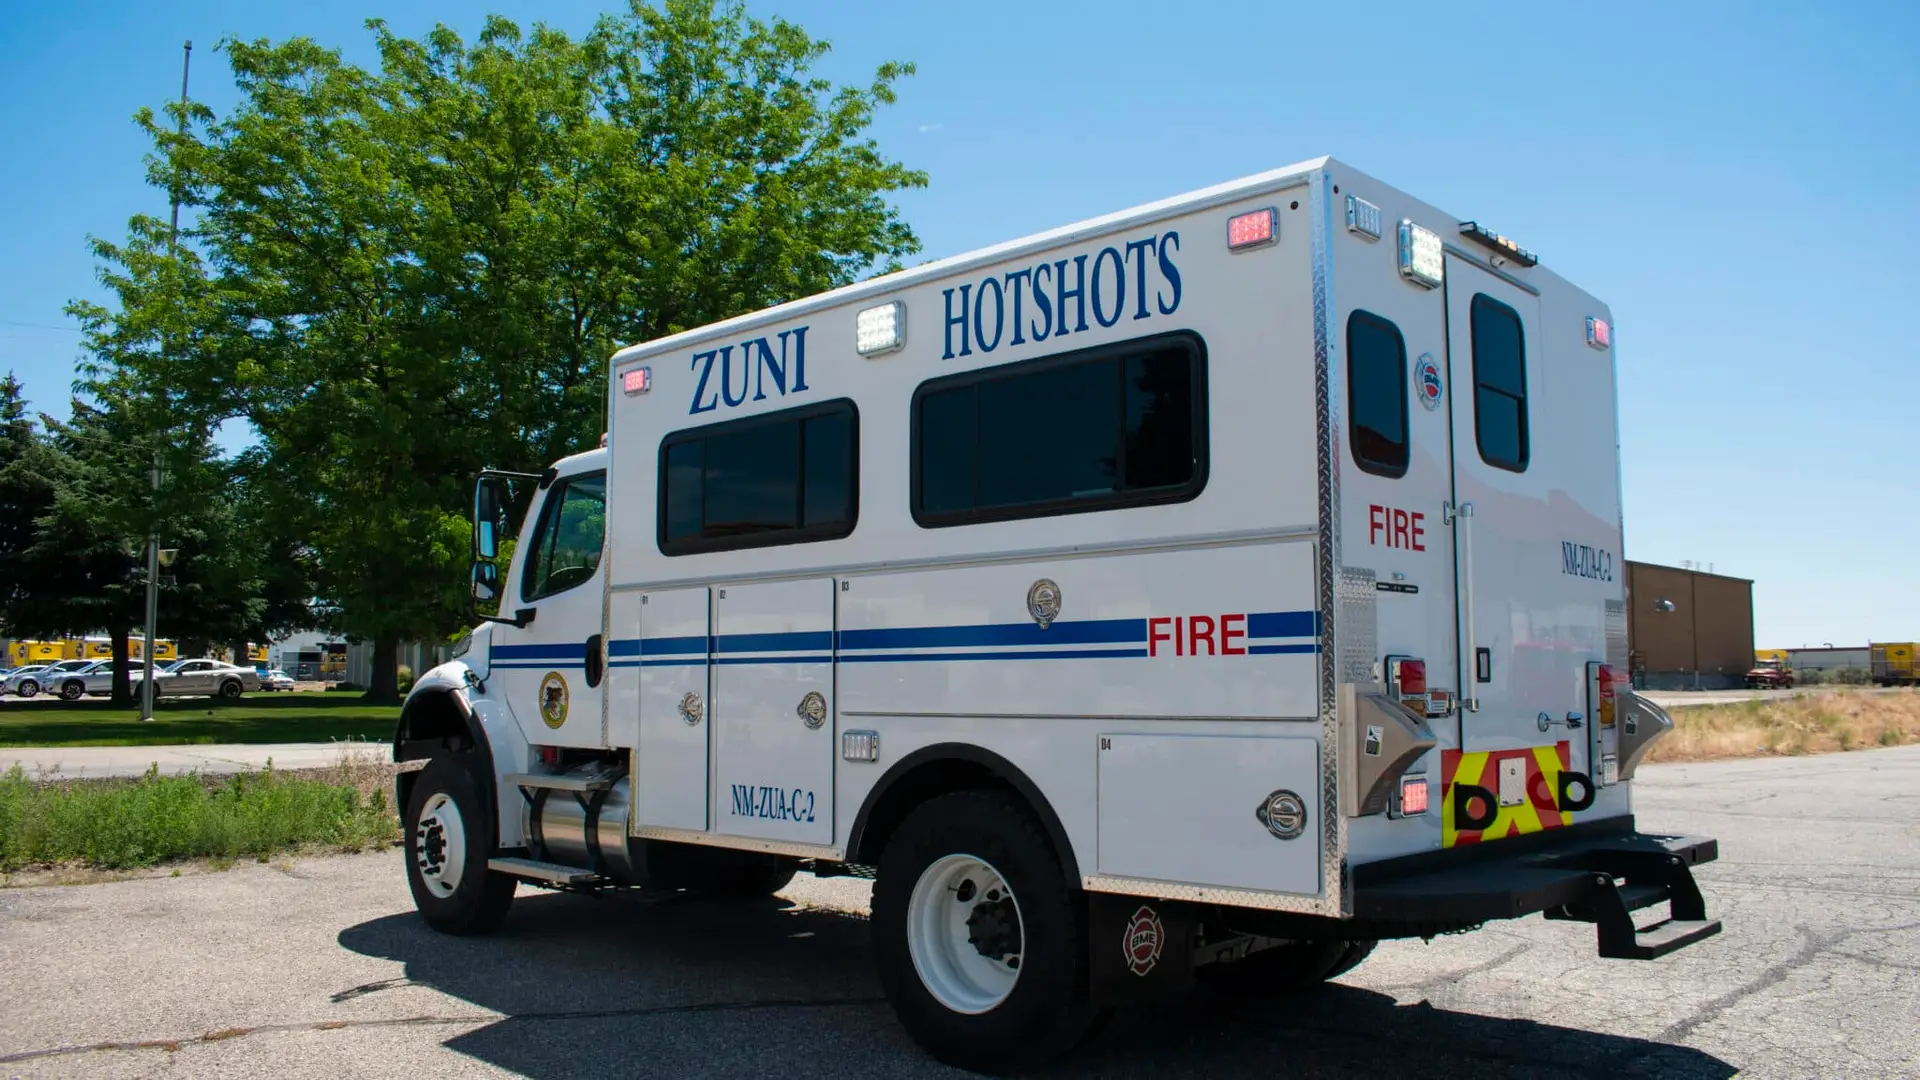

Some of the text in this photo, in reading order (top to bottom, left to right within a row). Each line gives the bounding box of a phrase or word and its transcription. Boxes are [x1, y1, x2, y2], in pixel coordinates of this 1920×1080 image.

[942, 231, 1182, 361] HOTSHOTS
[689, 325, 809, 415] ZUNI
[1369, 504, 1425, 552] FIRE
[1561, 541, 1612, 582] NM-ZUA-C-2
[1149, 614, 1246, 657] FIRE
[731, 784, 815, 823] NM-ZUA-C-2
